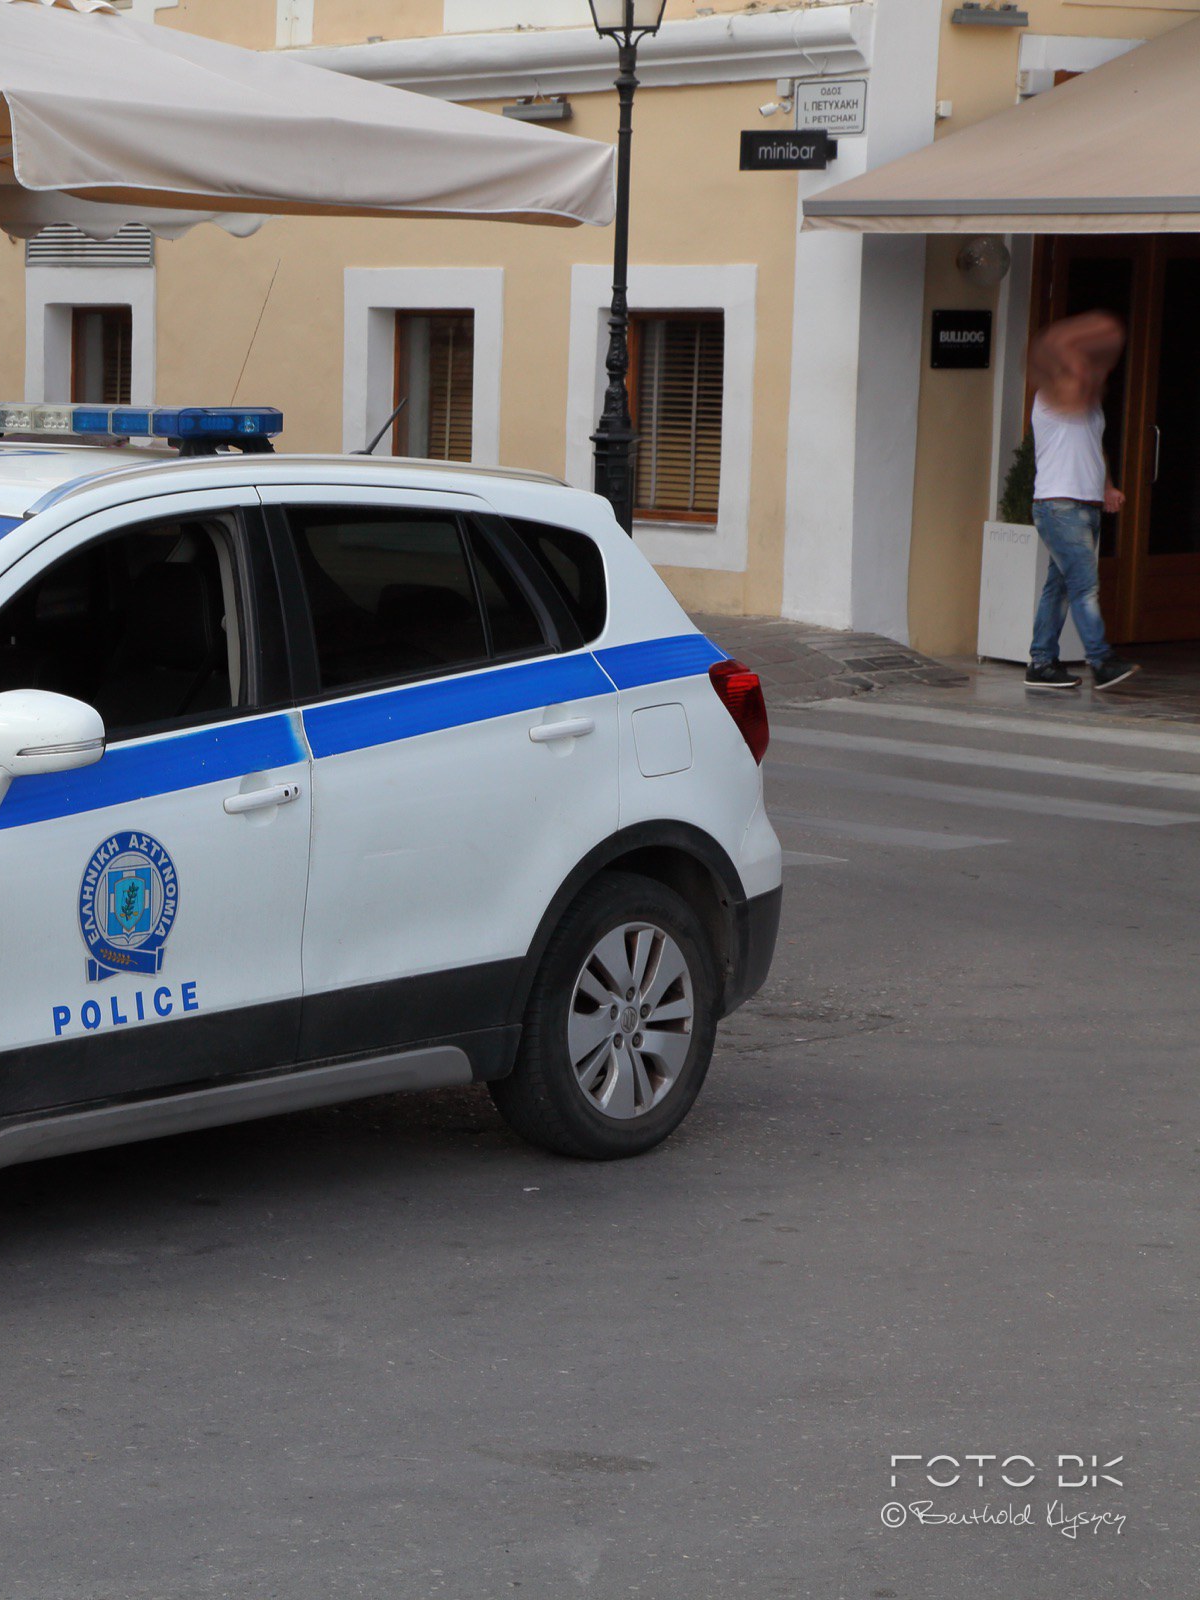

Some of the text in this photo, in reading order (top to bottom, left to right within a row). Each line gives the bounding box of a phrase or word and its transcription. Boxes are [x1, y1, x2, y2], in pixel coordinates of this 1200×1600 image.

[820, 86, 842, 96] ΟΔΟΣ
[811, 99, 859, 112] ΠΕΤΥΧΑΚΗ
[812, 114, 857, 124] PETICHAKI
[758, 142, 816, 160] minibar
[939, 330, 986, 343] BULLDOG
[81, 833, 177, 946] ΕΛΛΗΝΙΚΗ ΑΣΤΥΝΟΜΙΑ
[52, 981, 200, 1036] POLICE
